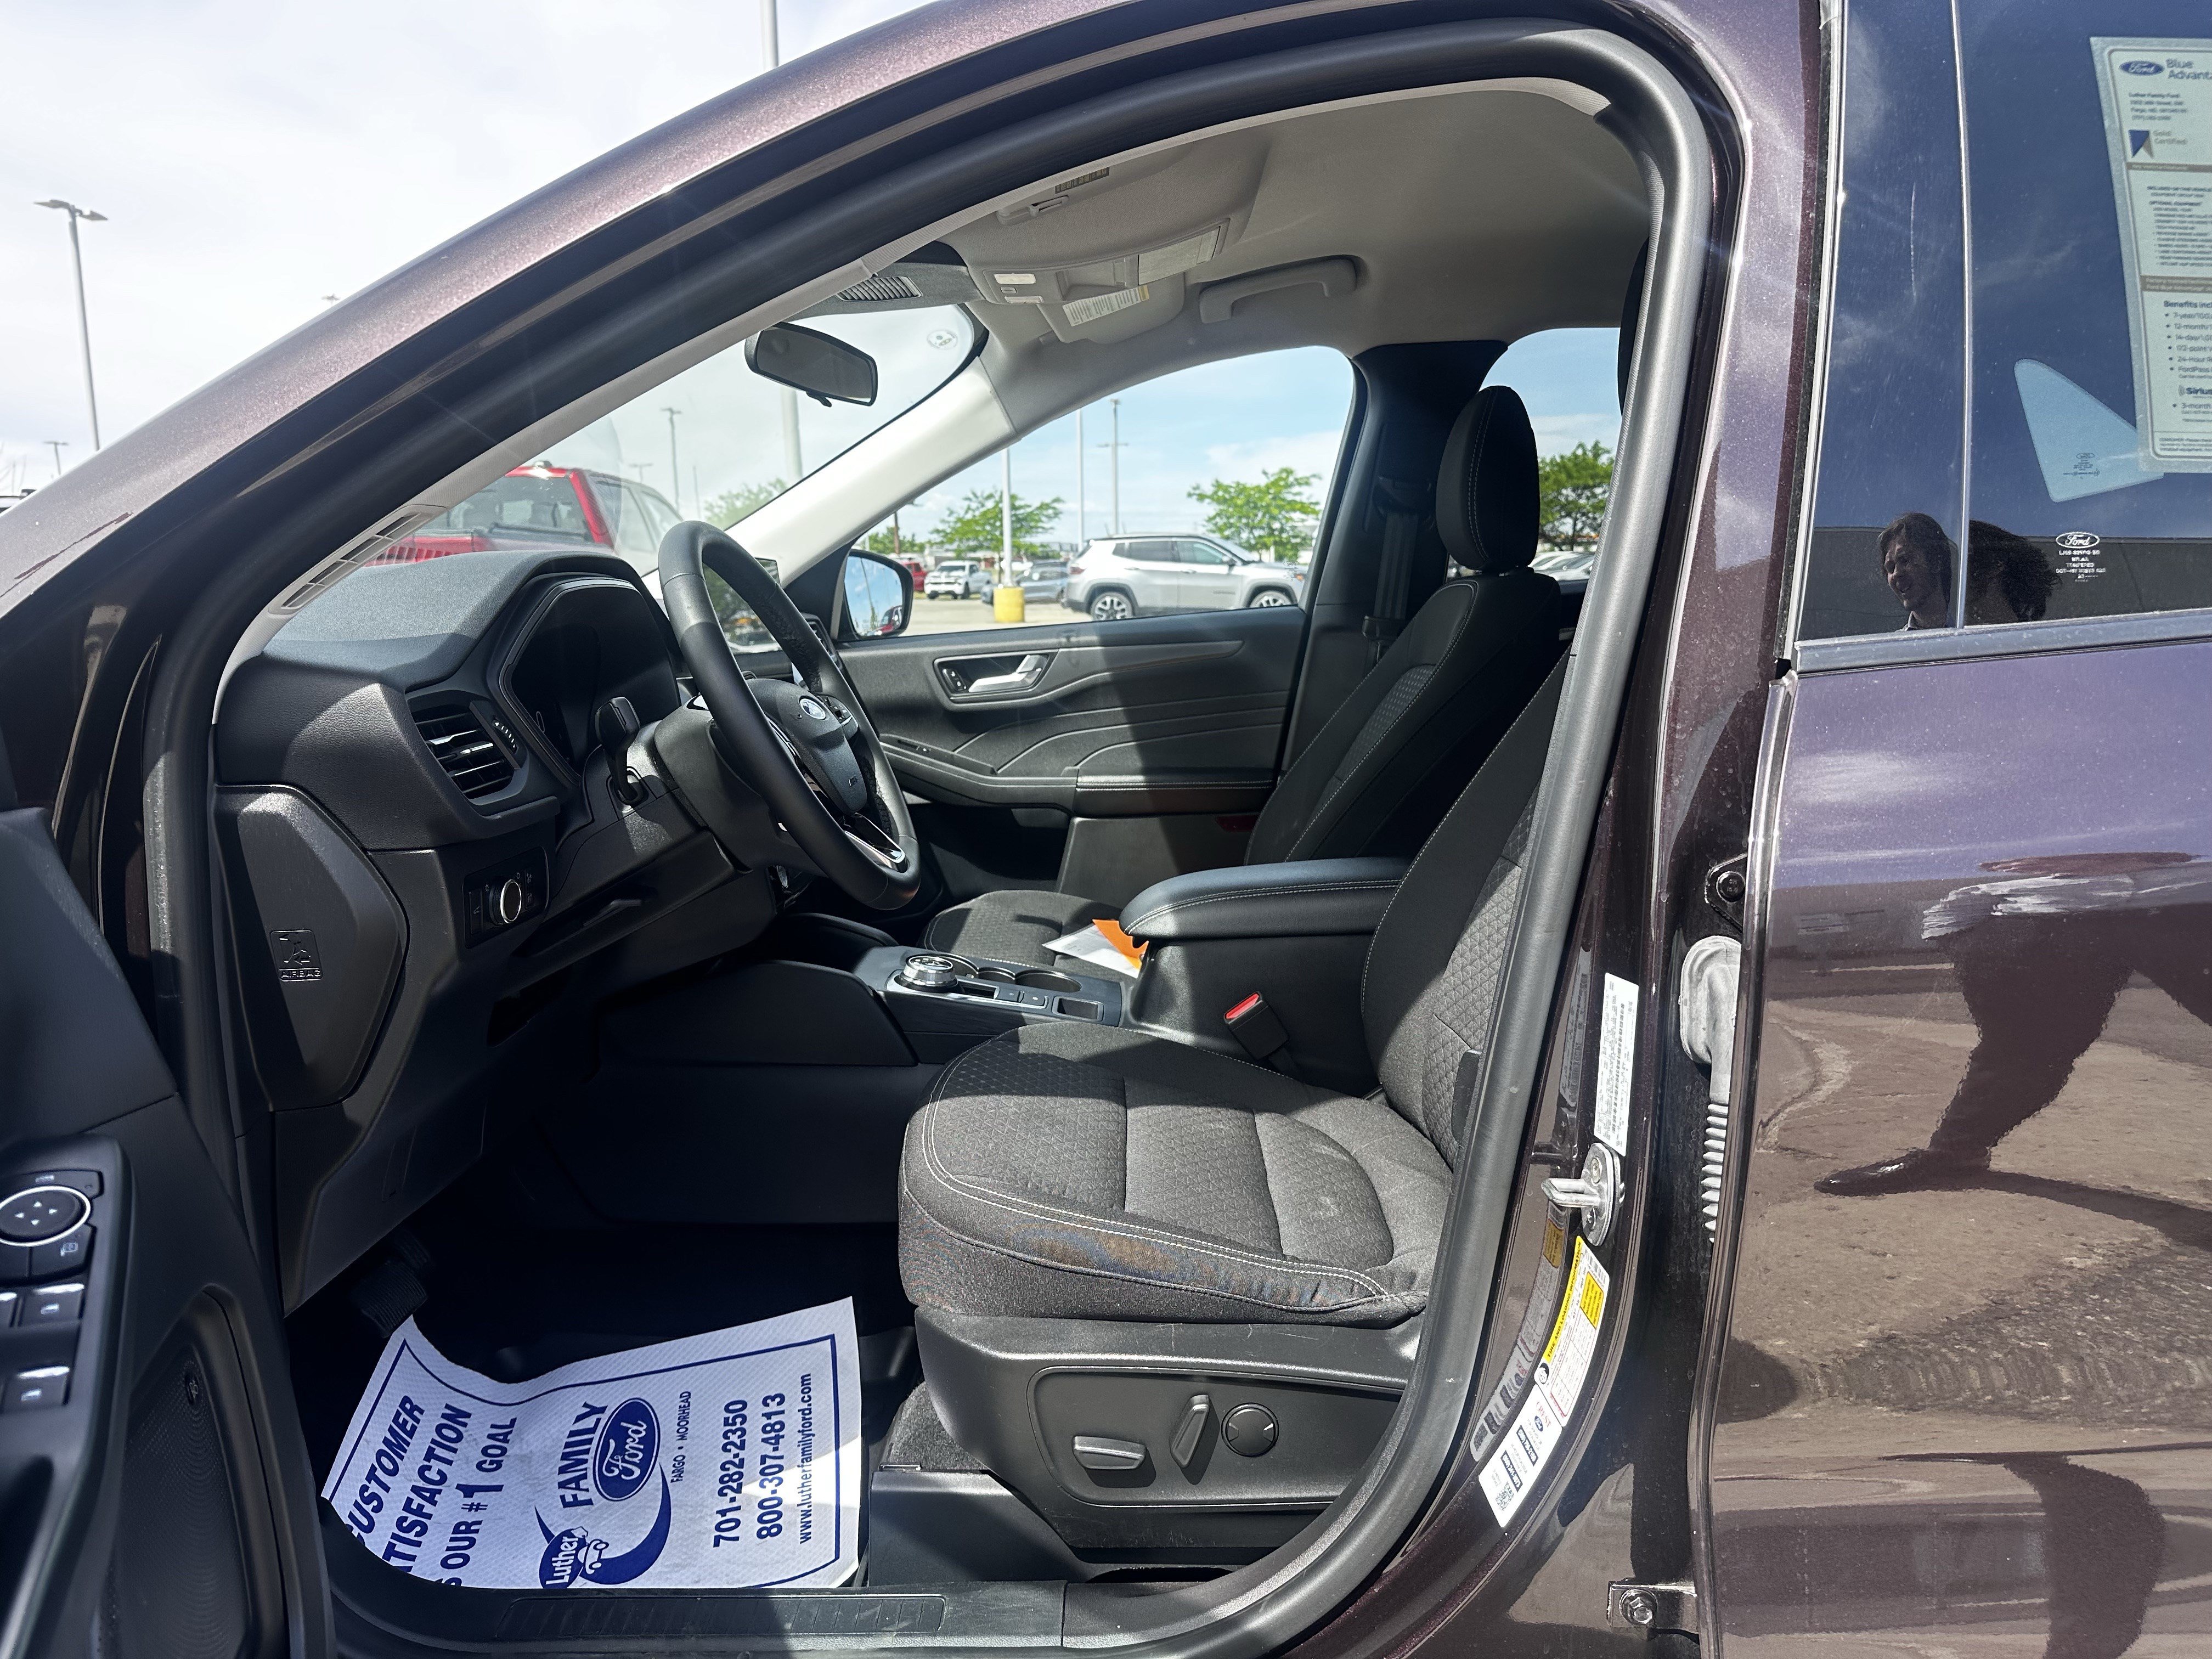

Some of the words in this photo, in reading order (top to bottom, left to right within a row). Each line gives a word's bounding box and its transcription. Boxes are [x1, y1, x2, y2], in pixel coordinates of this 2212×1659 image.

[2165, 58, 2194, 69] Blue
[676, 1391, 692, 1442] MOORHEAD
[475, 1417, 517, 1472] GOAL
[557, 1401, 608, 1509] FAMILY
[602, 1420, 647, 1480] Ford
[670, 1454, 686, 1483] FARGO
[756, 1392, 786, 1539] 800-307-4813
[797, 1373, 816, 1545] www.lutherfamilyford.com
[381, 1403, 472, 1573] TISFACTION
[455, 1483, 504, 1513] #1
[713, 1399, 748, 1548] 701-282-2350
[439, 1519, 483, 1570] OUR
[545, 1536, 579, 1585] Luther
